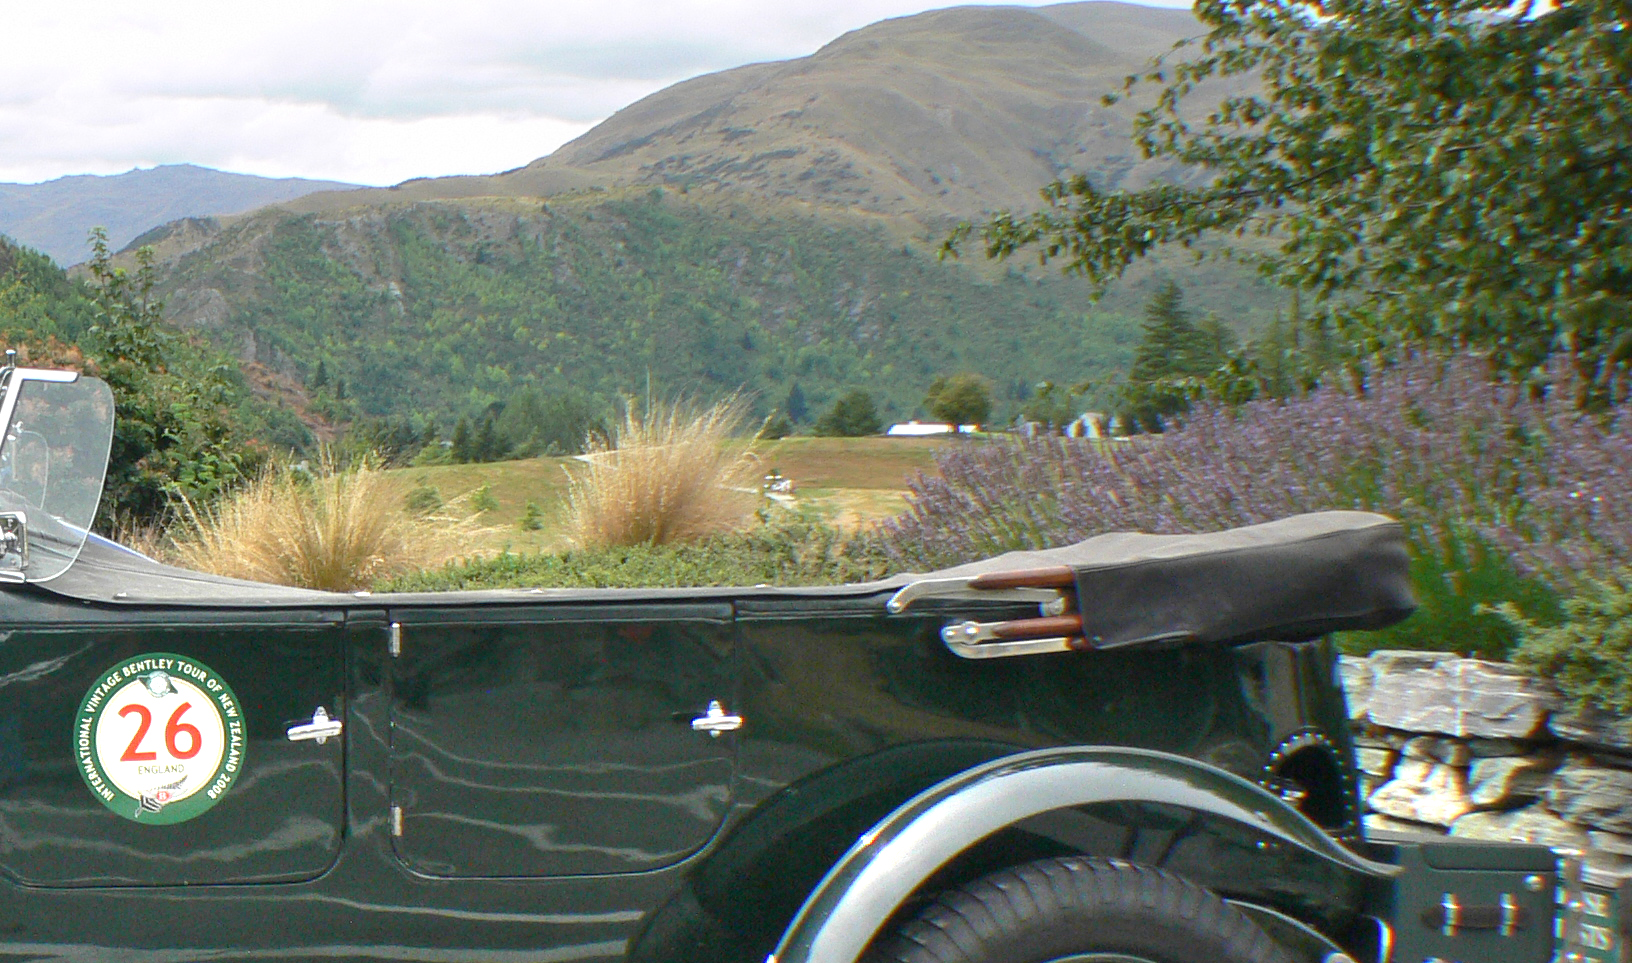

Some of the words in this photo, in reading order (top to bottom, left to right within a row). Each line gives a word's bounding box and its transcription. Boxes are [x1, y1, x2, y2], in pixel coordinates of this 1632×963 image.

[122, 658, 174, 678] BENTLEY
[177, 661, 208, 683] TOUR
[85, 671, 123, 713] VINTAGE
[206, 678, 223, 693] OF
[218, 693, 238, 717] NEW
[117, 701, 202, 762] 26
[226, 720, 242, 773] ZEALAND
[79, 717, 115, 802] INTERNATIONAL
[137, 764, 185, 775] ENGLAND
[206, 773, 231, 800] 2008
